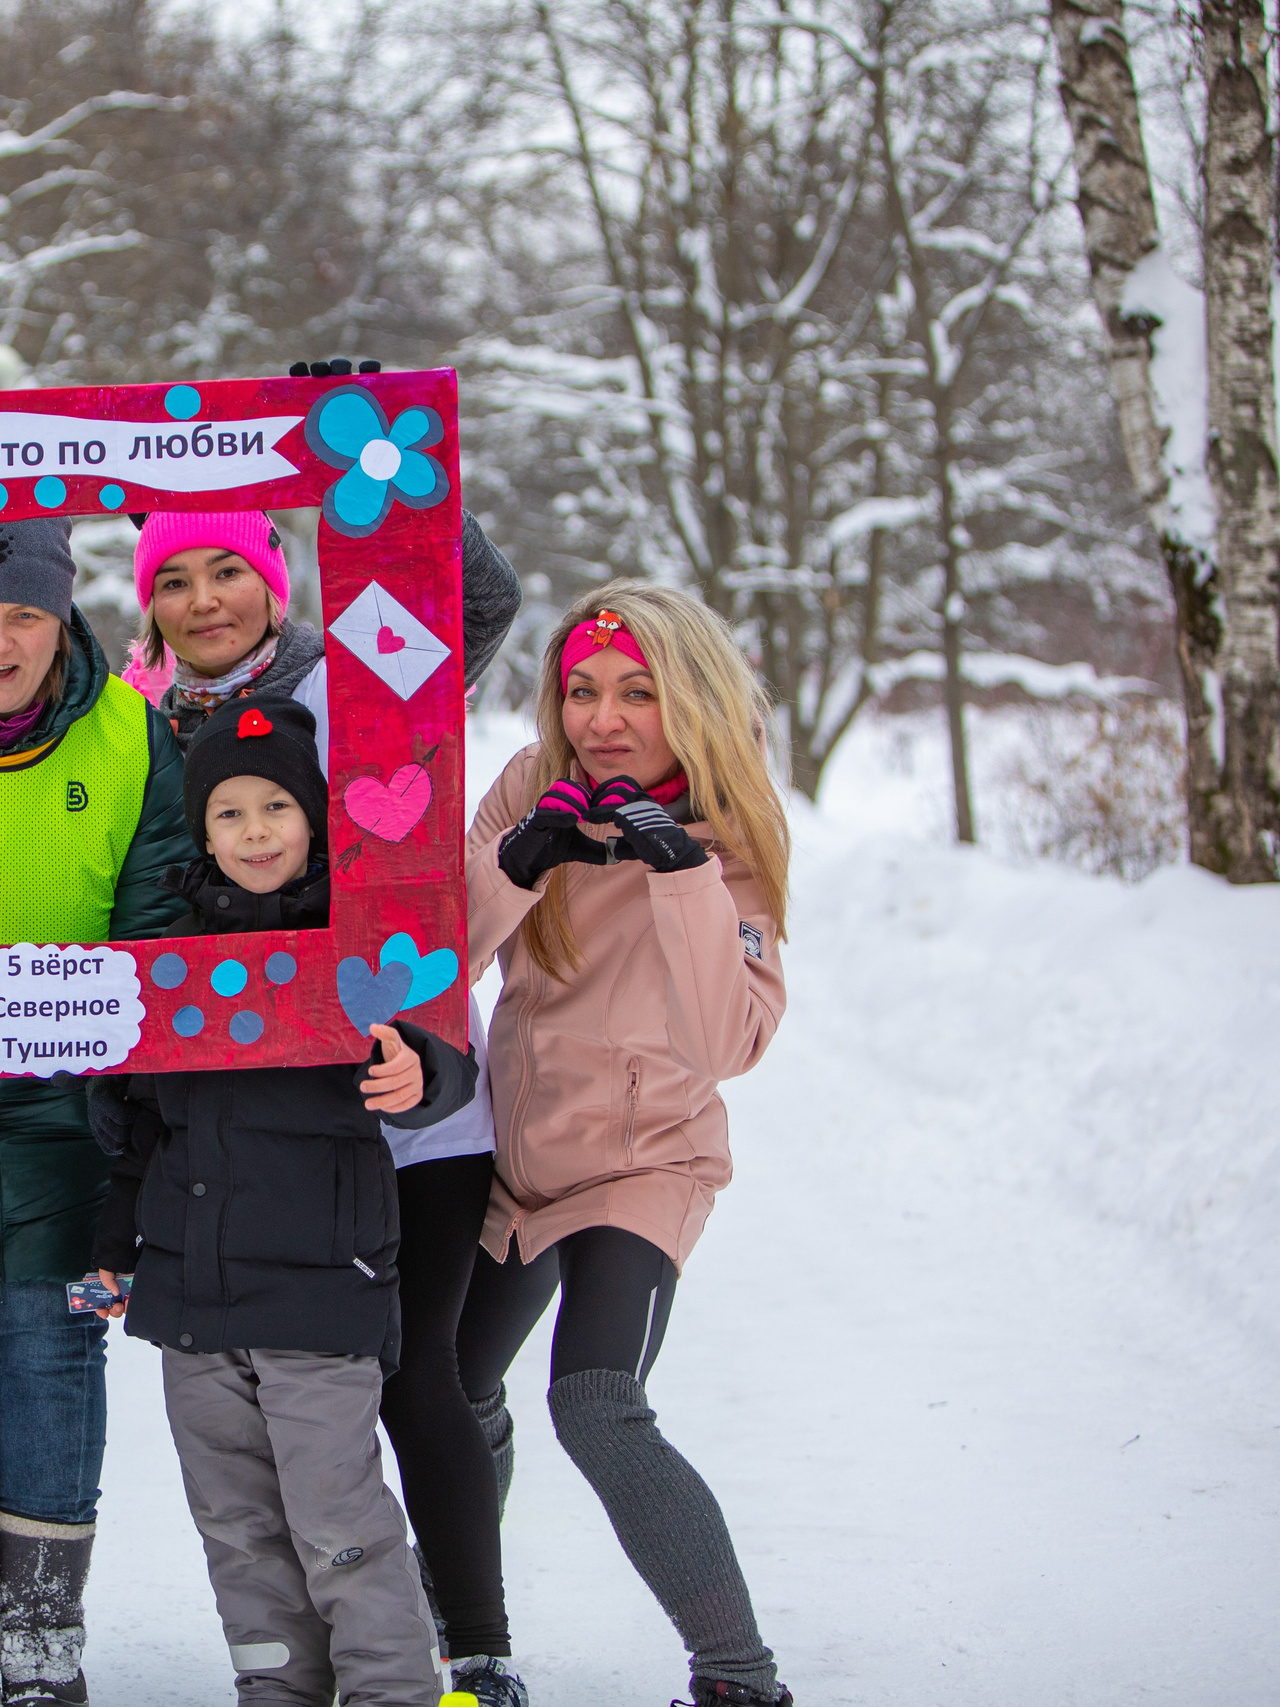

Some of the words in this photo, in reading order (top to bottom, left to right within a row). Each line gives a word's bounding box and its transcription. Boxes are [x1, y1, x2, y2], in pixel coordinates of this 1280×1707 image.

[58, 440, 107, 466] по
[128, 423, 265, 461] любви
[7, 954, 22, 976] 5
[31, 953, 105, 980] вёрст
[1, 1037, 108, 1063] Тушино
